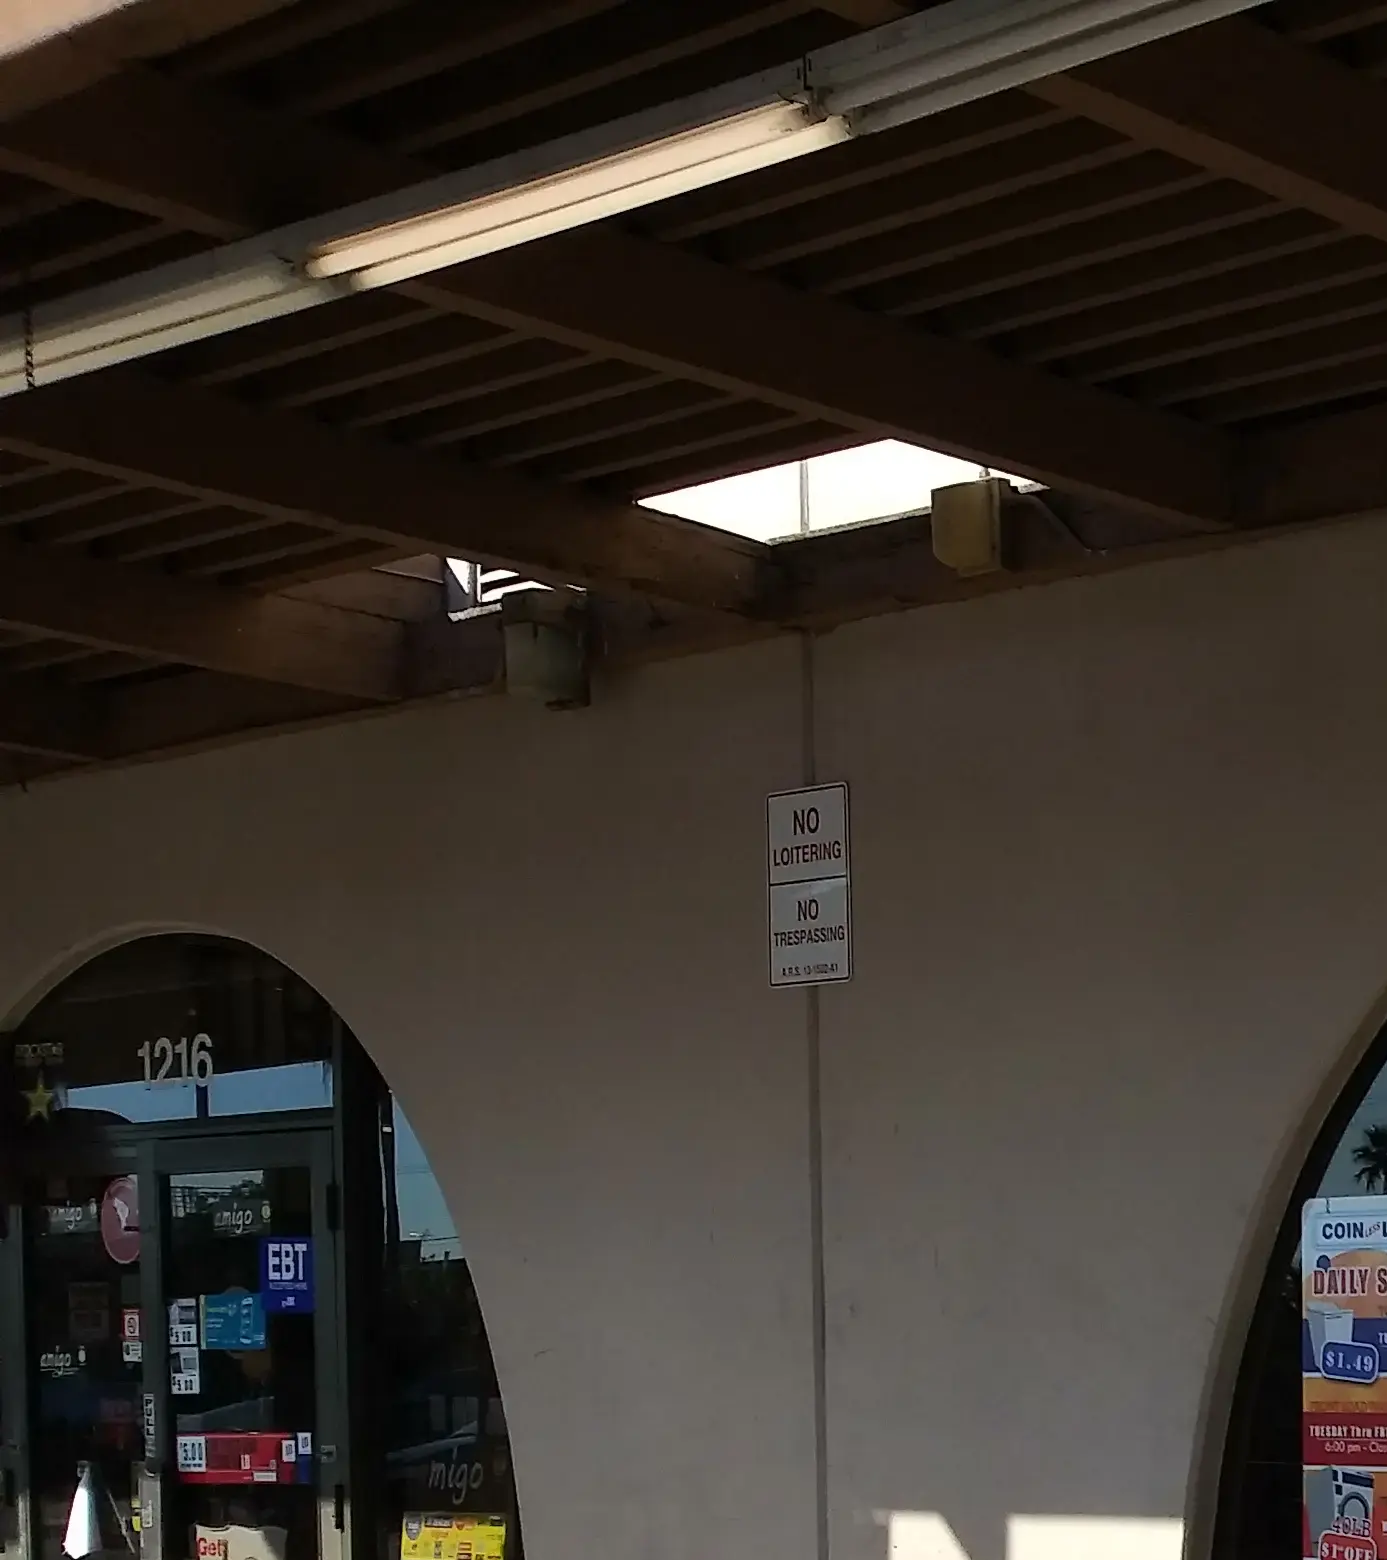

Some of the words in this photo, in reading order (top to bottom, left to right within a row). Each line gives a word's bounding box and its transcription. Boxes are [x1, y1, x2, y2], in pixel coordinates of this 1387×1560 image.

[793, 807, 821, 836] NO
[773, 840, 842, 867] LOITERING
[797, 899, 819, 922] NO
[773, 925, 845, 948] TRESPASSING
[137, 1032, 213, 1087] 1216
[214, 1202, 253, 1233] amigo
[1321, 1222, 1364, 1240] COIN
[268, 1243, 308, 1281] EBT
[1313, 1267, 1369, 1295] DAILY
[40, 1346, 72, 1378] amigo
[1325, 1351, 1373, 1372] $1.49
[1309, 1426, 1348, 1438] TUESDAY
